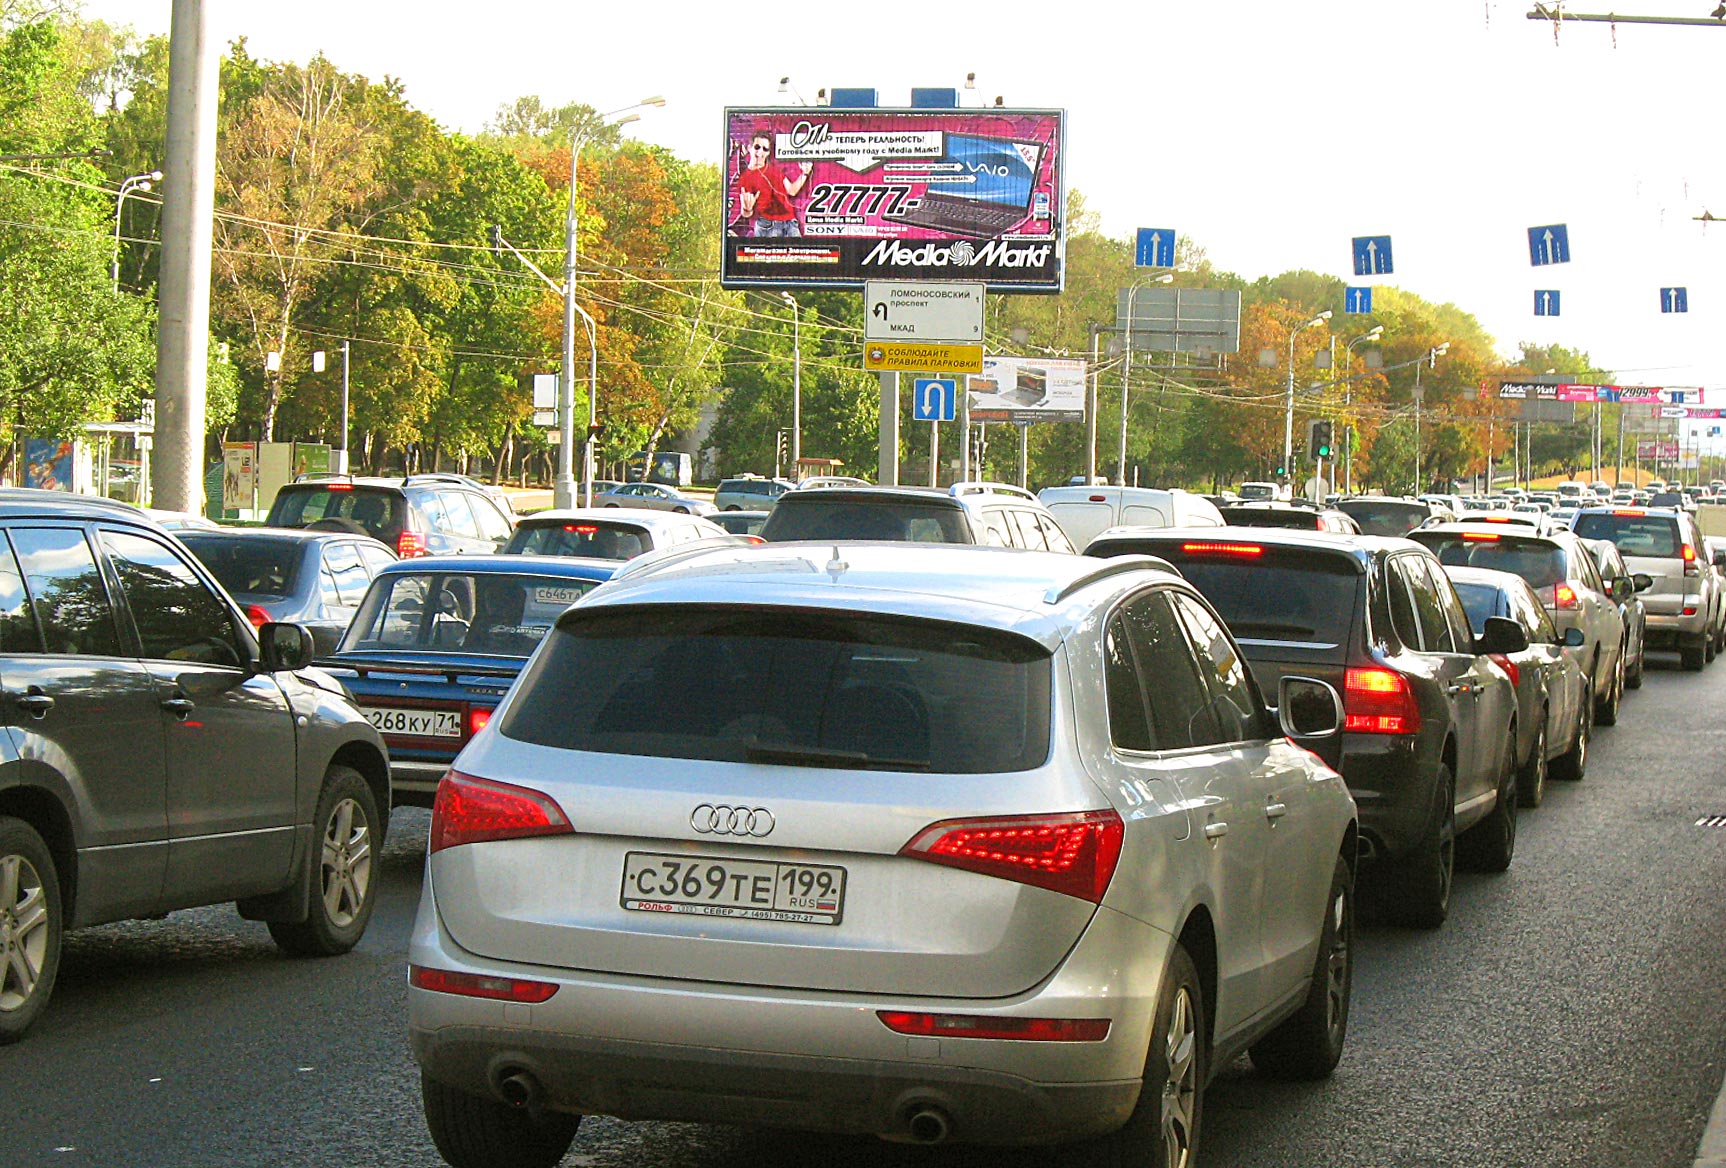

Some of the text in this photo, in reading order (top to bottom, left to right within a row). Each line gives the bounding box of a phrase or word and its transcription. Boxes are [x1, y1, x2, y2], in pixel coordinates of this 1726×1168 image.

[835, 135, 867, 144] ТЕПЕРЬ
[868, 135, 925, 144] РЕАЛЬНОСТЬ!
[966, 161, 1009, 177] VAIO
[806, 226, 845, 234] SONY
[861, 240, 1049, 268] Media Markt
[890, 289, 971, 299] ЛОМОНОСОВСКИЙ
[890, 324, 979, 333] МКАД 9
[887, 358, 928, 367] ПРАВИЛА
[930, 359, 979, 369] ПАРКОВКИ!
[437, 713, 455, 729] 71
[636, 862, 833, 904] С369ТЕ 199
[789, 897, 816, 909] RUS
[637, 902, 814, 922] РОЛЬФ СЕВЕР (495) 785-27-27
